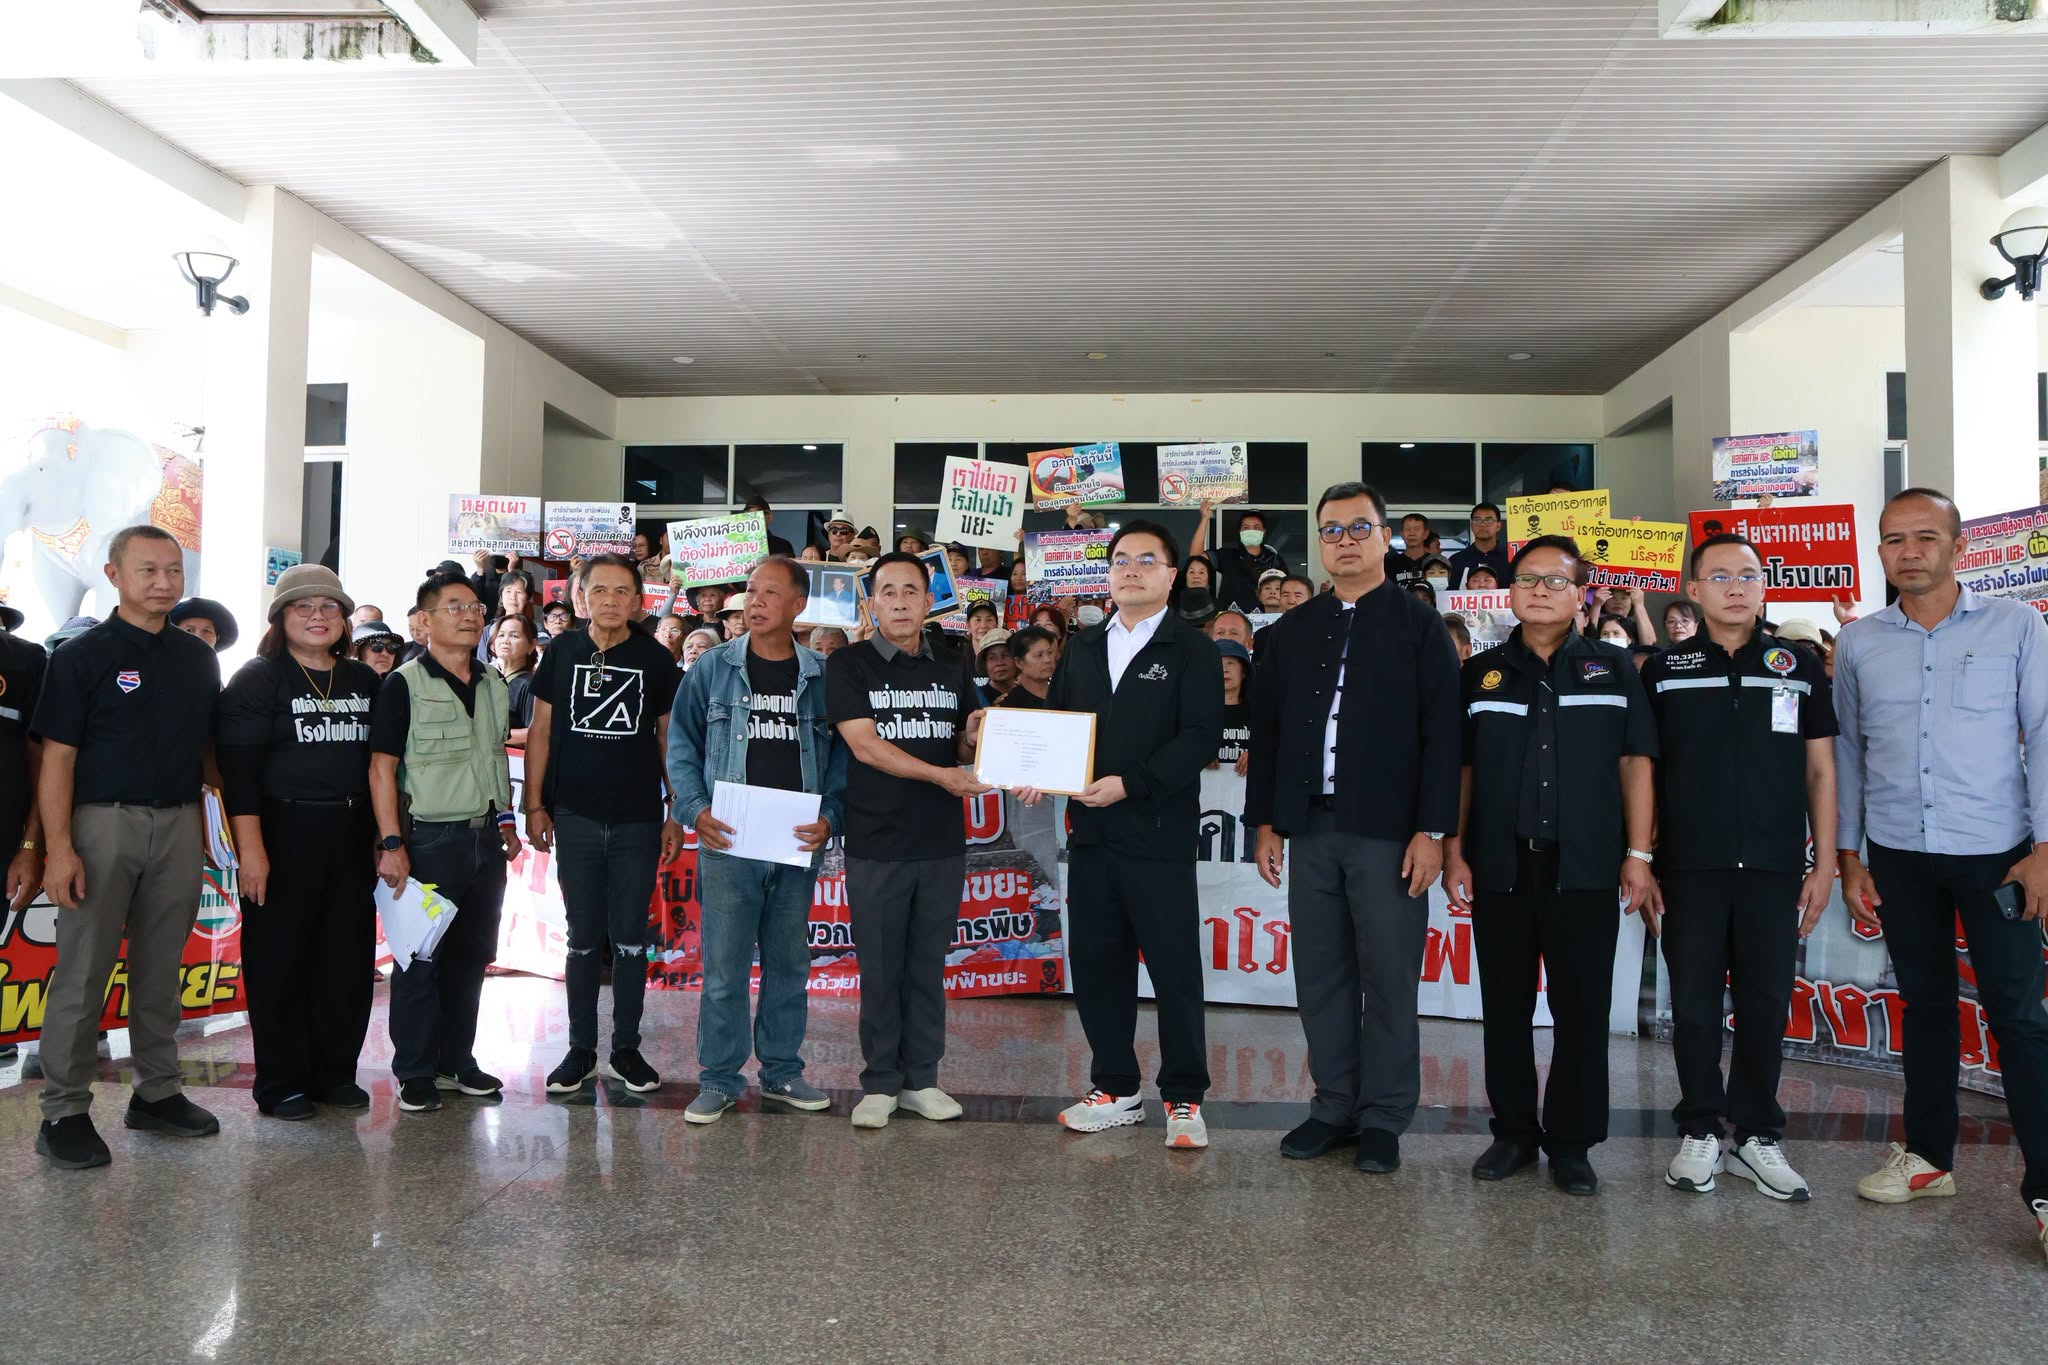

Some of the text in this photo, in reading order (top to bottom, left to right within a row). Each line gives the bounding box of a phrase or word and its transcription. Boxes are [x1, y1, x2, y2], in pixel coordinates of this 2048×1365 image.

[1051, 445, 1113, 469] อากาศวันนี้
[953, 461, 1017, 494] เราไม่เอา
[1054, 479, 1101, 493] คือลมหายใจ
[1188, 472, 1245, 484] ร่วมกันคัดค้าน
[461, 499, 527, 518] หยุดเผา
[1038, 488, 1121, 510] ของลูกหลานในวันหน้า
[1509, 495, 1608, 515] เราต้องการอากาศ
[575, 530, 633, 541] ร่วมกันคัดค้าน
[673, 519, 760, 541] พลังงานสะอาด
[961, 514, 995, 536] ขยะ
[1577, 520, 1684, 542] เราต้องการอากาศ
[1971, 516, 2033, 539] และชมรมผู้สูงอายุ
[679, 541, 759, 562] ต้องไม่ทำลาย
[1631, 543, 1678, 567] บริสุทธิ์
[2006, 544, 2025, 562] และ
[584, 671, 632, 728] L A
[874, 712, 956, 740] รงไฟฟ้าขยะ
